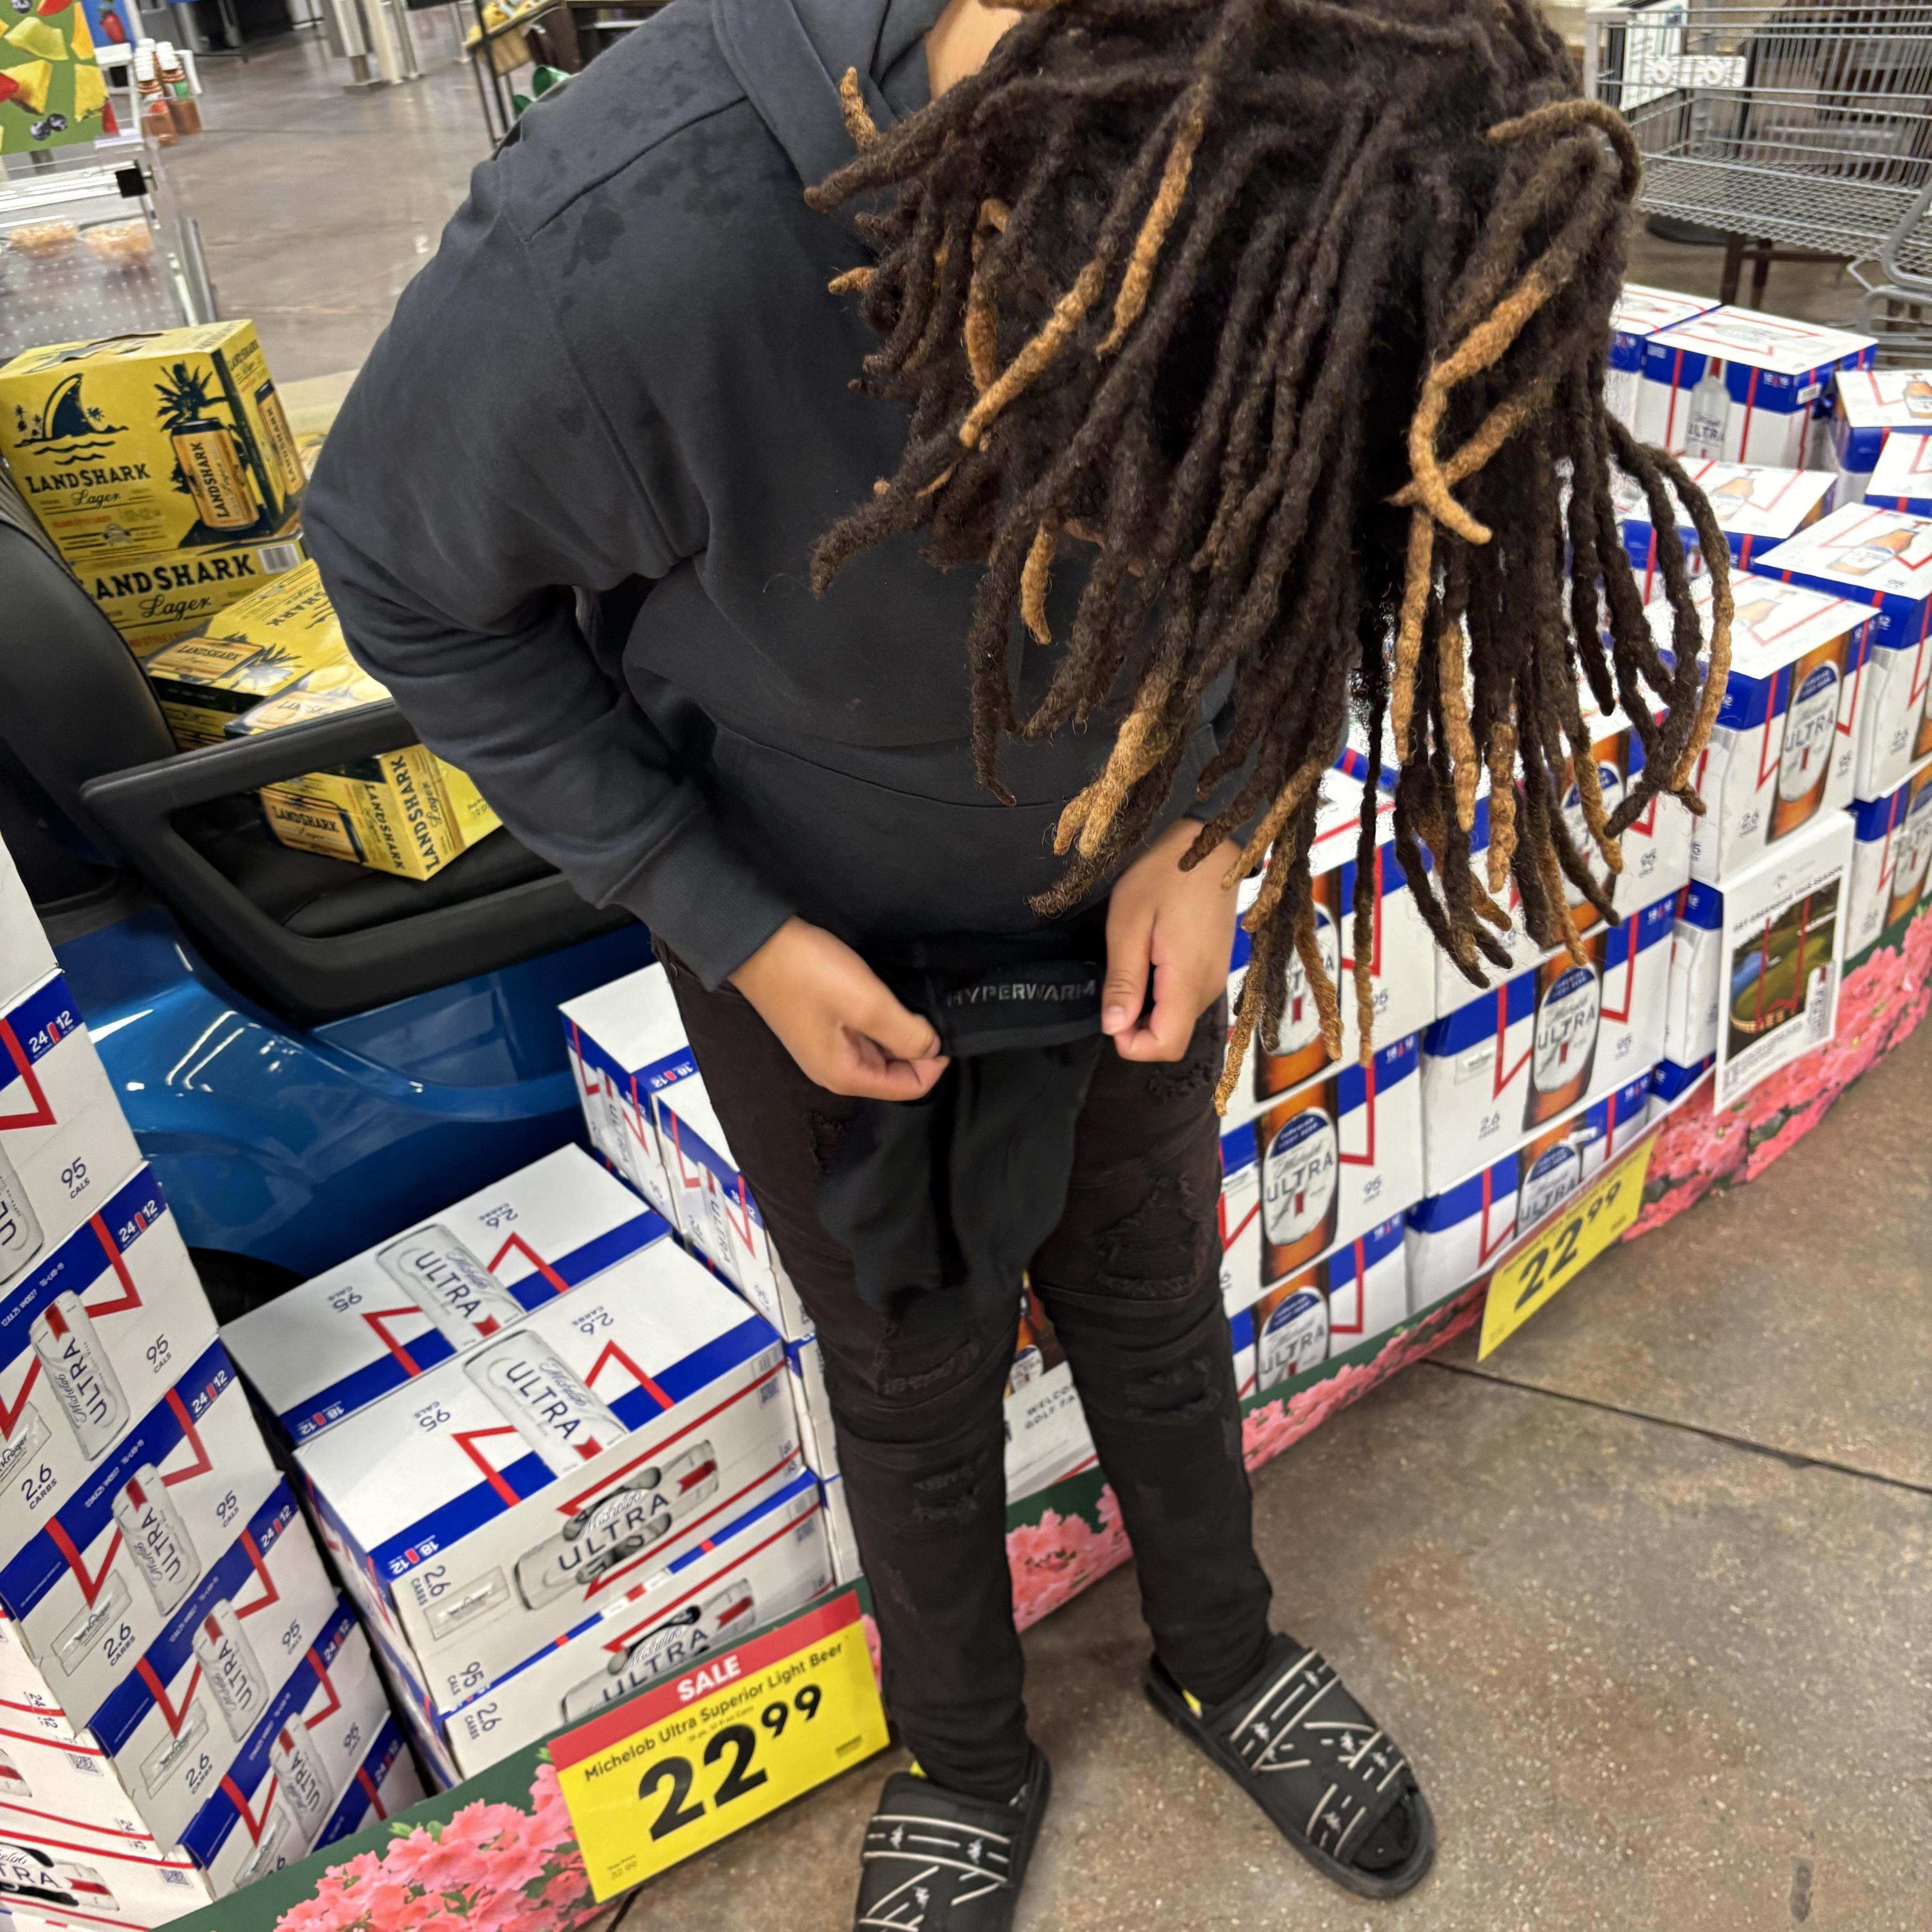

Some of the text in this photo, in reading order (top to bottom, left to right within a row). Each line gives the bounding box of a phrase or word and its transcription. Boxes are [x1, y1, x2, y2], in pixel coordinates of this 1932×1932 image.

[25, 464, 151, 494] LANDSHARK
[190, 442, 230, 518] LANDSHARK
[70, 488, 121, 508] Lager
[78, 553, 256, 602] ANDSHARK
[138, 593, 212, 621] Lager
[272, 806, 340, 833] LANDSHARK
[390, 755, 440, 872] LANDSHARK
[421, 781, 443, 828] Lager
[364, 783, 405, 869] LANDSHARK
[28, 1010, 74, 1054] 24 12
[1537, 1004, 1596, 1051] ULTRA
[60, 1156, 87, 1190] 95
[69, 1177, 91, 1200] CALS
[1265, 1152, 1334, 1203] ULTRA
[118, 1199, 158, 1243] 24 12
[485, 1207, 519, 1229] 2.6
[445, 1247, 488, 1290] Michelob
[1514, 1217, 1584, 1313] 22
[327, 1285, 353, 1302] CALS
[415, 1250, 482, 1320] ULTRA
[332, 1293, 363, 1313] 95
[572, 1306, 604, 1326] CARBS
[580, 1311, 614, 1335] 2.6
[145, 1333, 169, 1366] 95
[153, 1352, 173, 1375] CALS
[1261, 1324, 1325, 1375] ULTRA
[62, 1336, 108, 1426] ULTRA
[191, 1369, 228, 1415] 24 12
[540, 1357, 587, 1408] Michelob
[414, 1401, 440, 1419] CALS
[506, 1360, 583, 1441] ULTRA
[1026, 1384, 1072, 1417] WELCO
[298, 1405, 345, 1436] 18 12
[419, 1411, 451, 1431] 95
[20, 1463, 52, 1503] 2.6
[29, 1477, 58, 1510] CARBS
[216, 1489, 238, 1520] 95
[586, 1489, 644, 1530] Michelob
[141, 1506, 181, 1582] ULTRA
[558, 1493, 670, 1571] ULTRA
[390, 1540, 440, 1574] 18 12
[410, 1577, 428, 1607] CARBS
[423, 1565, 452, 1597] 2.6
[103, 1621, 132, 1660] 2.6
[110, 1635, 136, 1667] CARBS
[281, 1619, 301, 1649] 95
[218, 1638, 253, 1711] ULTRA
[447, 1674, 461, 1695] CALS
[460, 1661, 484, 1688] 95
[676, 1656, 742, 1703] SALE
[465, 1715, 480, 1740] CARBS
[477, 1702, 503, 1731] 2.6
[584, 1642, 843, 1782] Michelob Ultra Superior Light Beer
[185, 1752, 209, 1788] 2.6
[638, 1683, 823, 1843] 22 99
[290, 1749, 322, 1813] ULTRA
[0, 1860, 63, 1889] TRA
